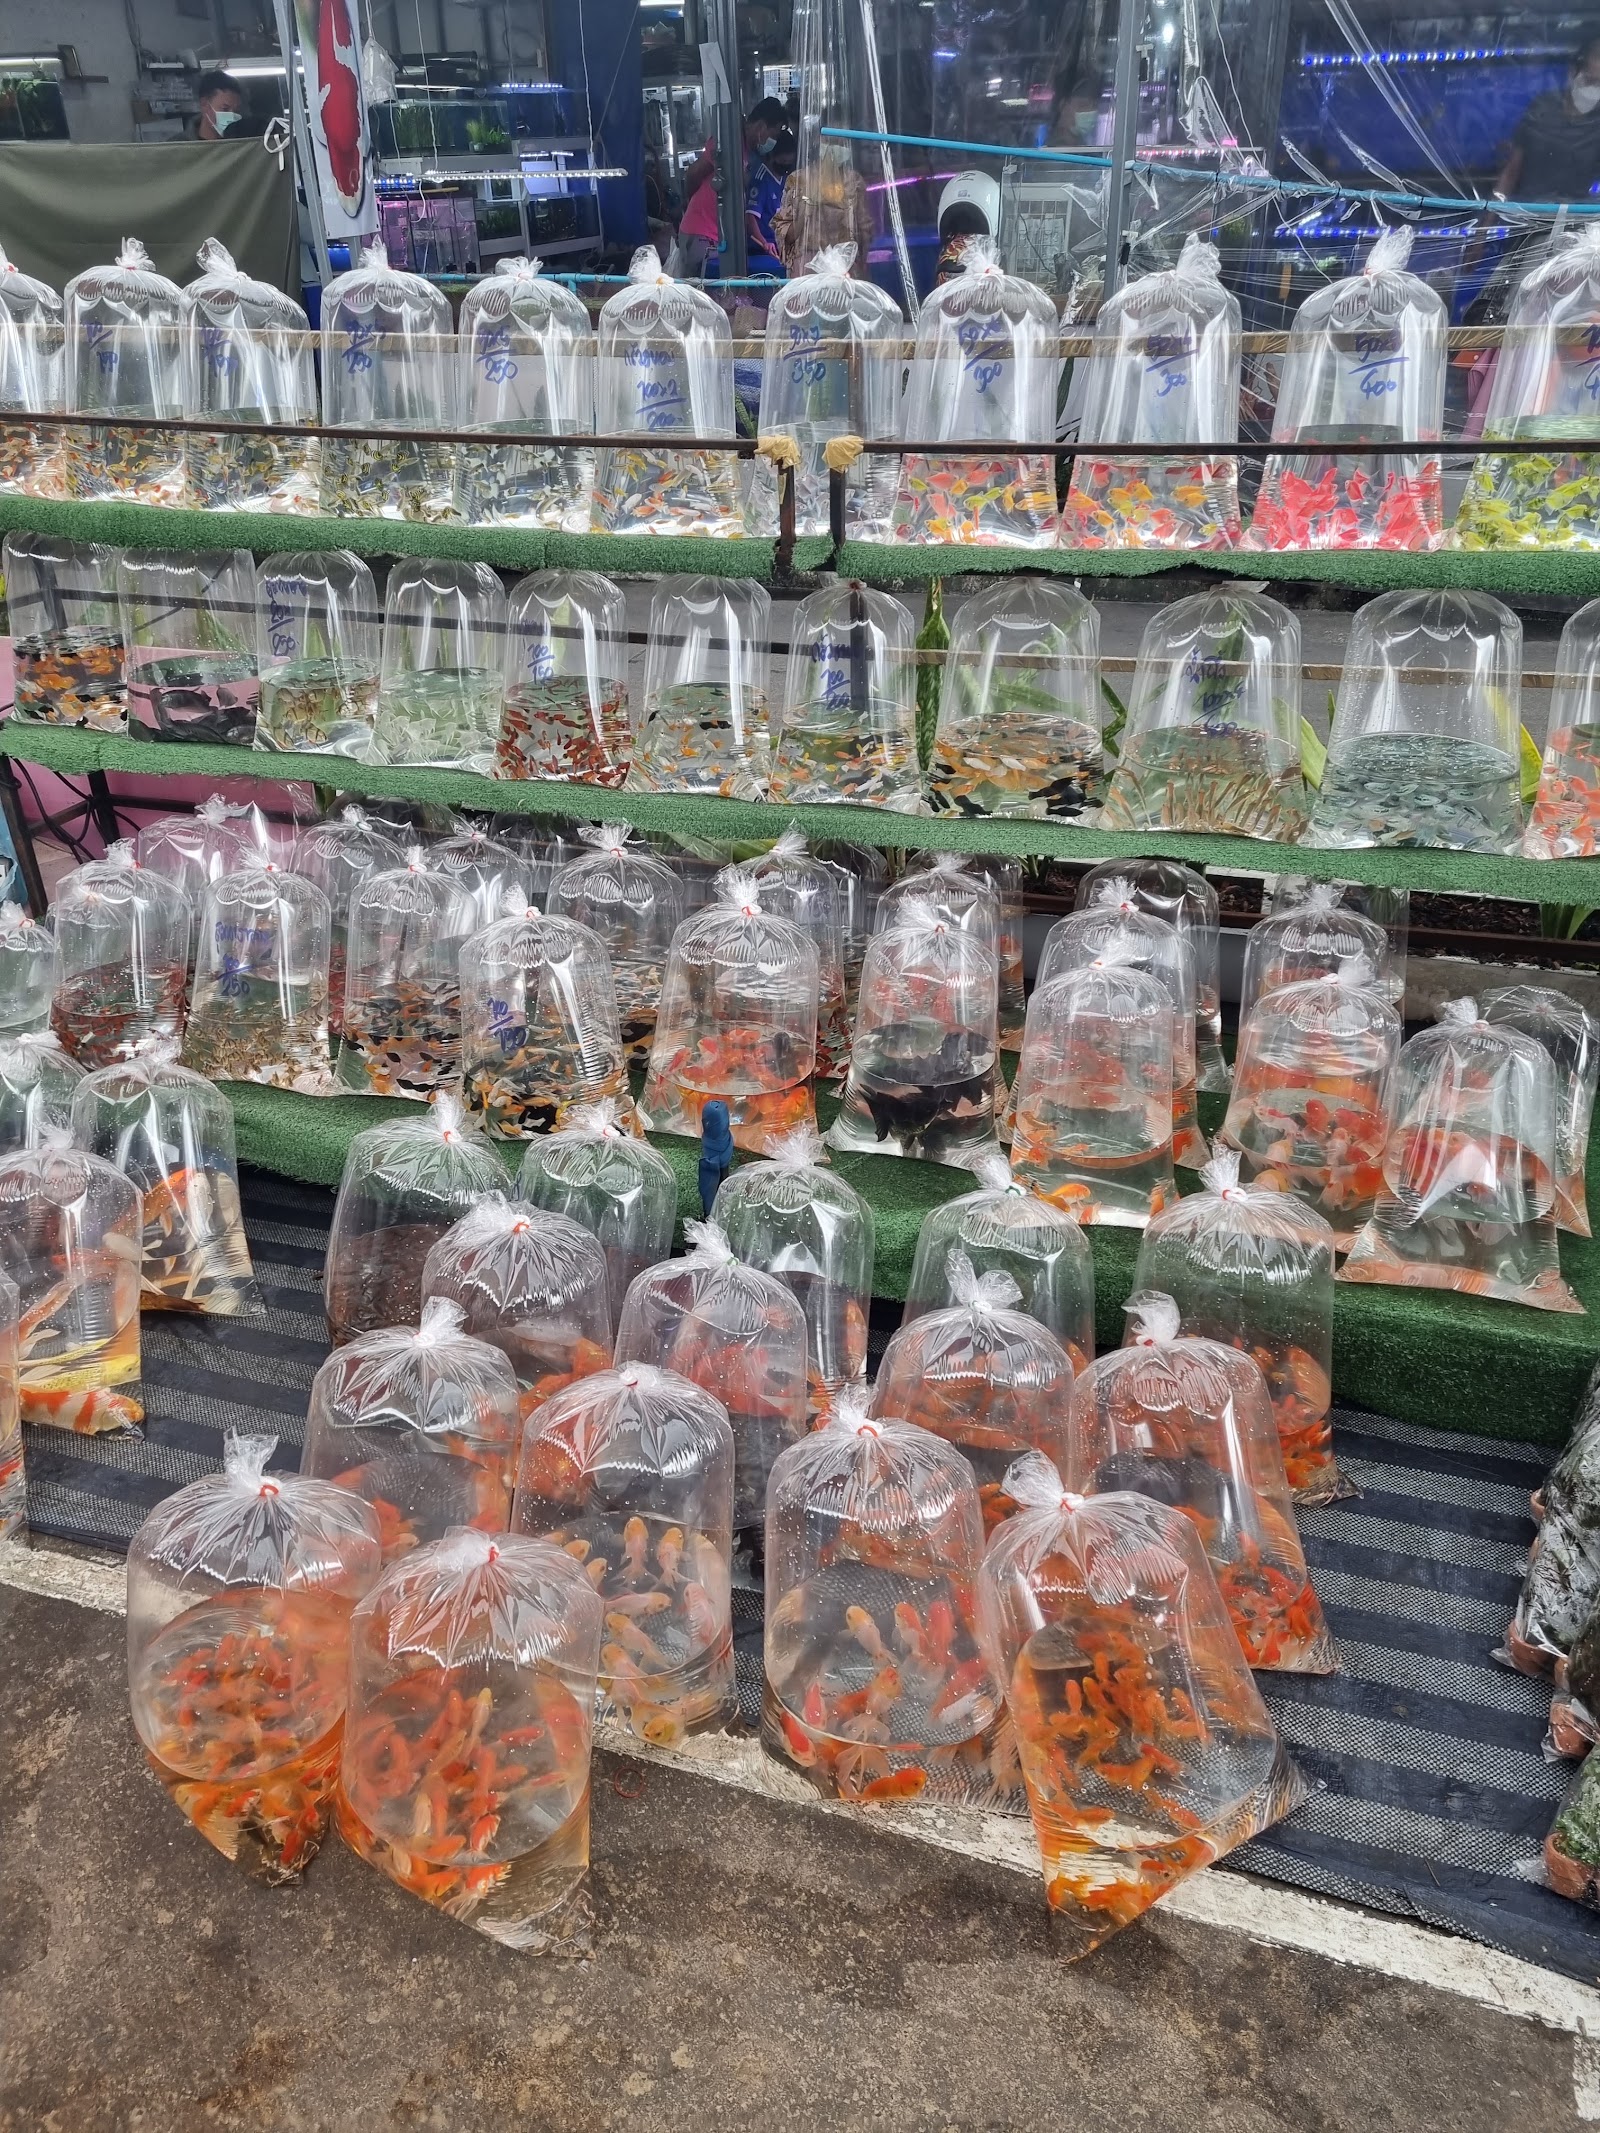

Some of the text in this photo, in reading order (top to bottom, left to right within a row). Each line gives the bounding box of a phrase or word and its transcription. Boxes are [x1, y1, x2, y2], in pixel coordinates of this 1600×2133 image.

[484, 356, 519, 384] 250
[973, 361, 1003, 394] 300
[1157, 368, 1188, 397] 300
[1360, 368, 1397, 400] 400
